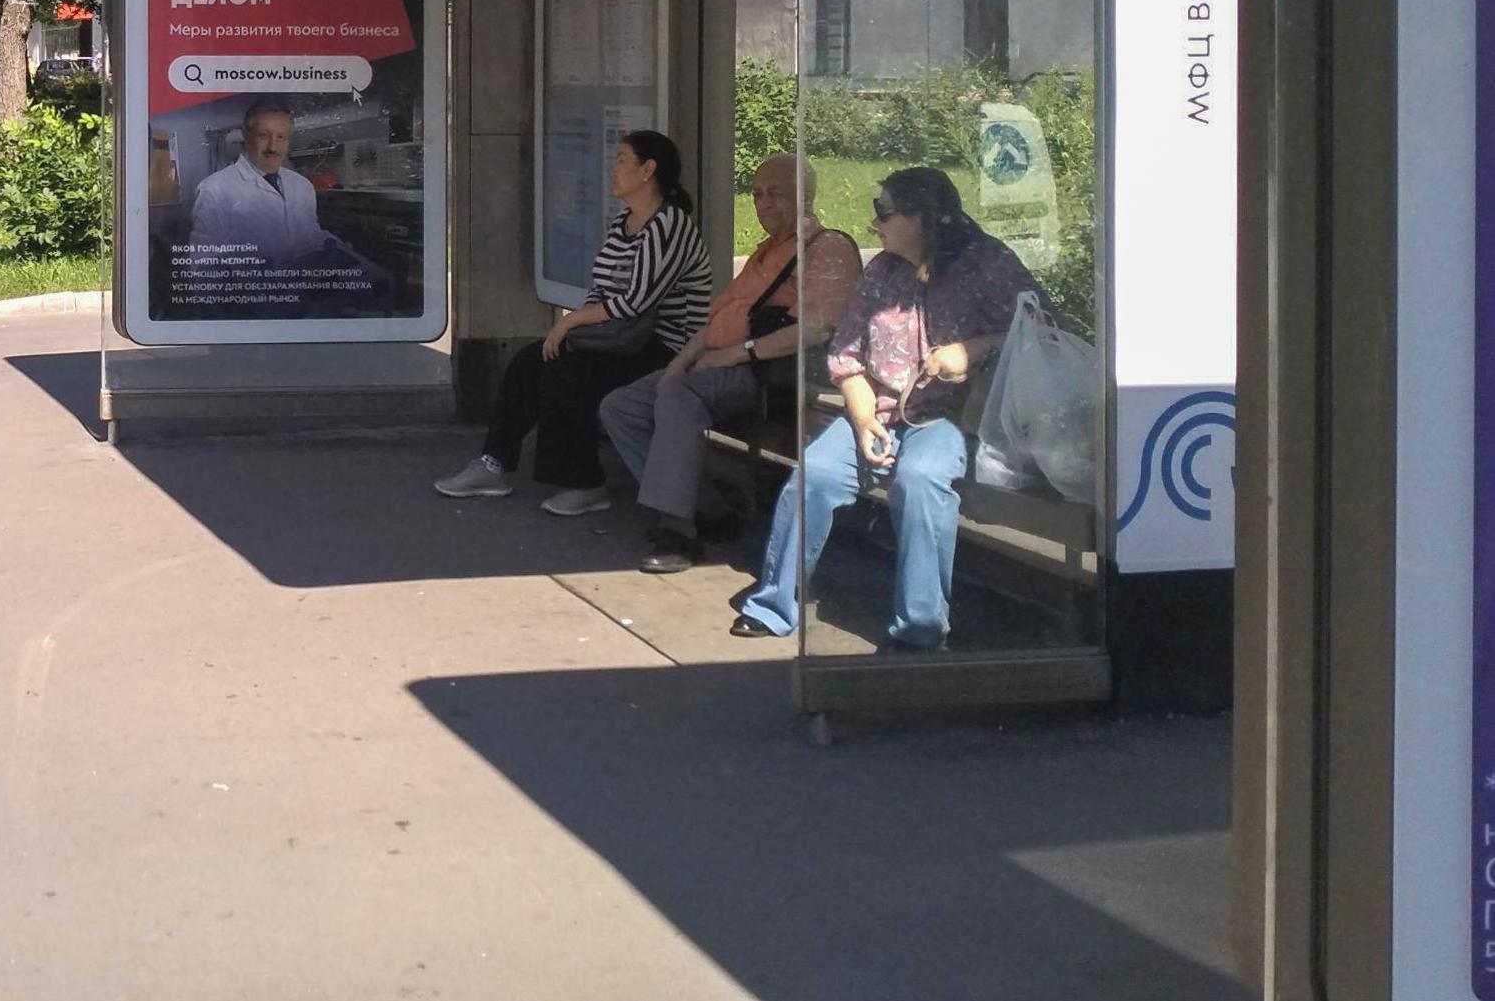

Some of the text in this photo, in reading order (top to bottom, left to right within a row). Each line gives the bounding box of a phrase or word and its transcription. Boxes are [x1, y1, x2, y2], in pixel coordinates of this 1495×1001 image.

[169, 22, 400, 39] Меры развития твоего бизнеса
[214, 65, 348, 81] moscow.business
[1187, 34, 1215, 125] МФЦ
[171, 242, 258, 253] ЯКОВ ГОЛЬДШТЕЙН
[171, 257, 193, 266] ООО
[171, 270, 179, 279] С
[180, 269, 230, 279] ПОМОЩЬЮ
[231, 269, 263, 278] ГРАНТА
[171, 283, 224, 292] УСТАНОВКУ
[225, 282, 244, 292] ДЛЯ
[332, 281, 372, 290] ВОЗДУХА
[171, 296, 184, 305] НА
